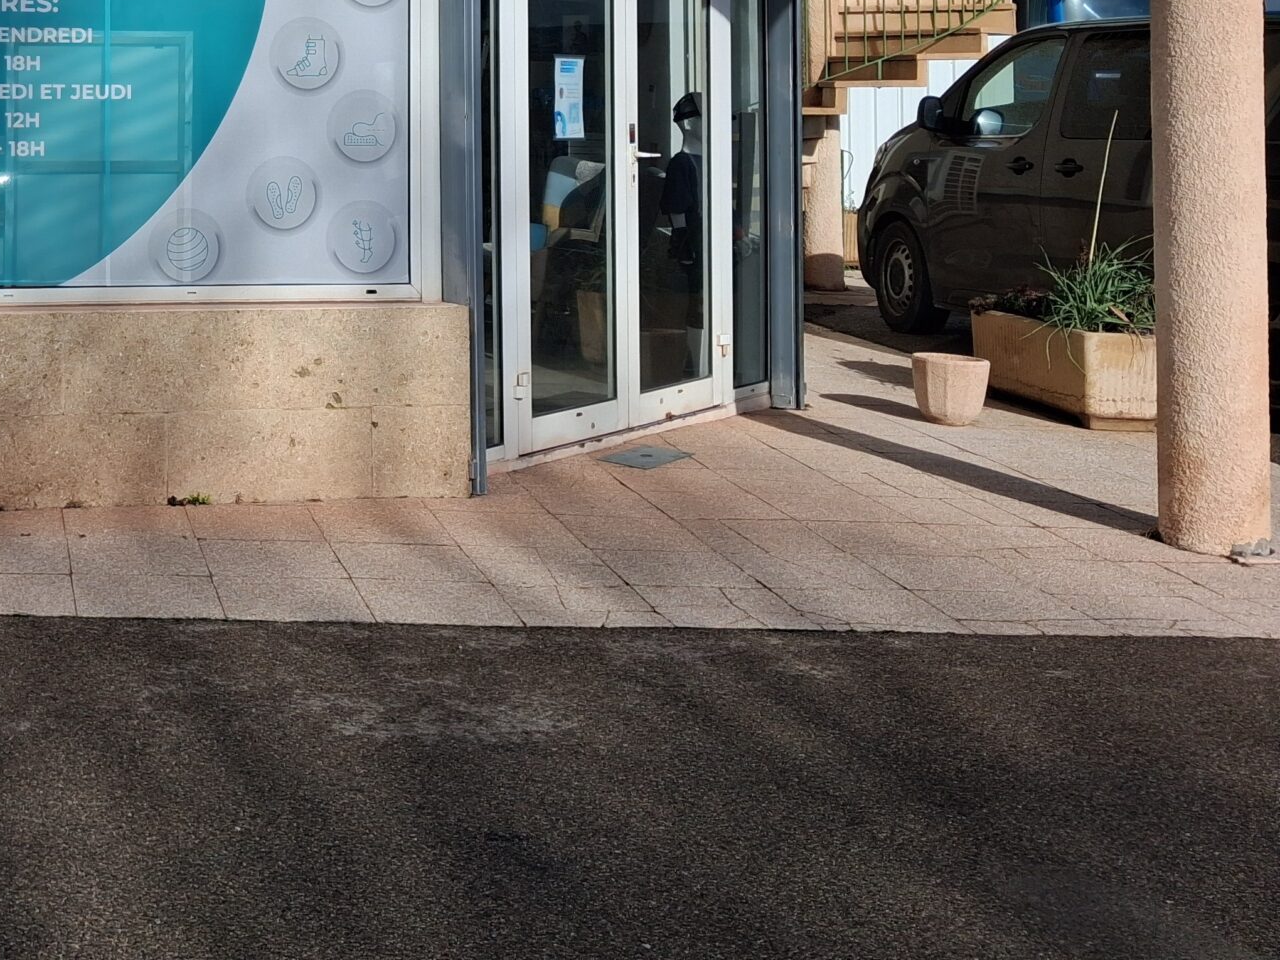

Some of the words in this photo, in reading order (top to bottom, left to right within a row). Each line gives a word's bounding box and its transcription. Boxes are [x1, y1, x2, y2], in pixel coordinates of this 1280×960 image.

[4, 55, 41, 72] 18H
[40, 83, 66, 100] ET
[70, 83, 132, 100] JEUDI
[4, 111, 41, 129] 12H
[8, 140, 45, 157] 18H
